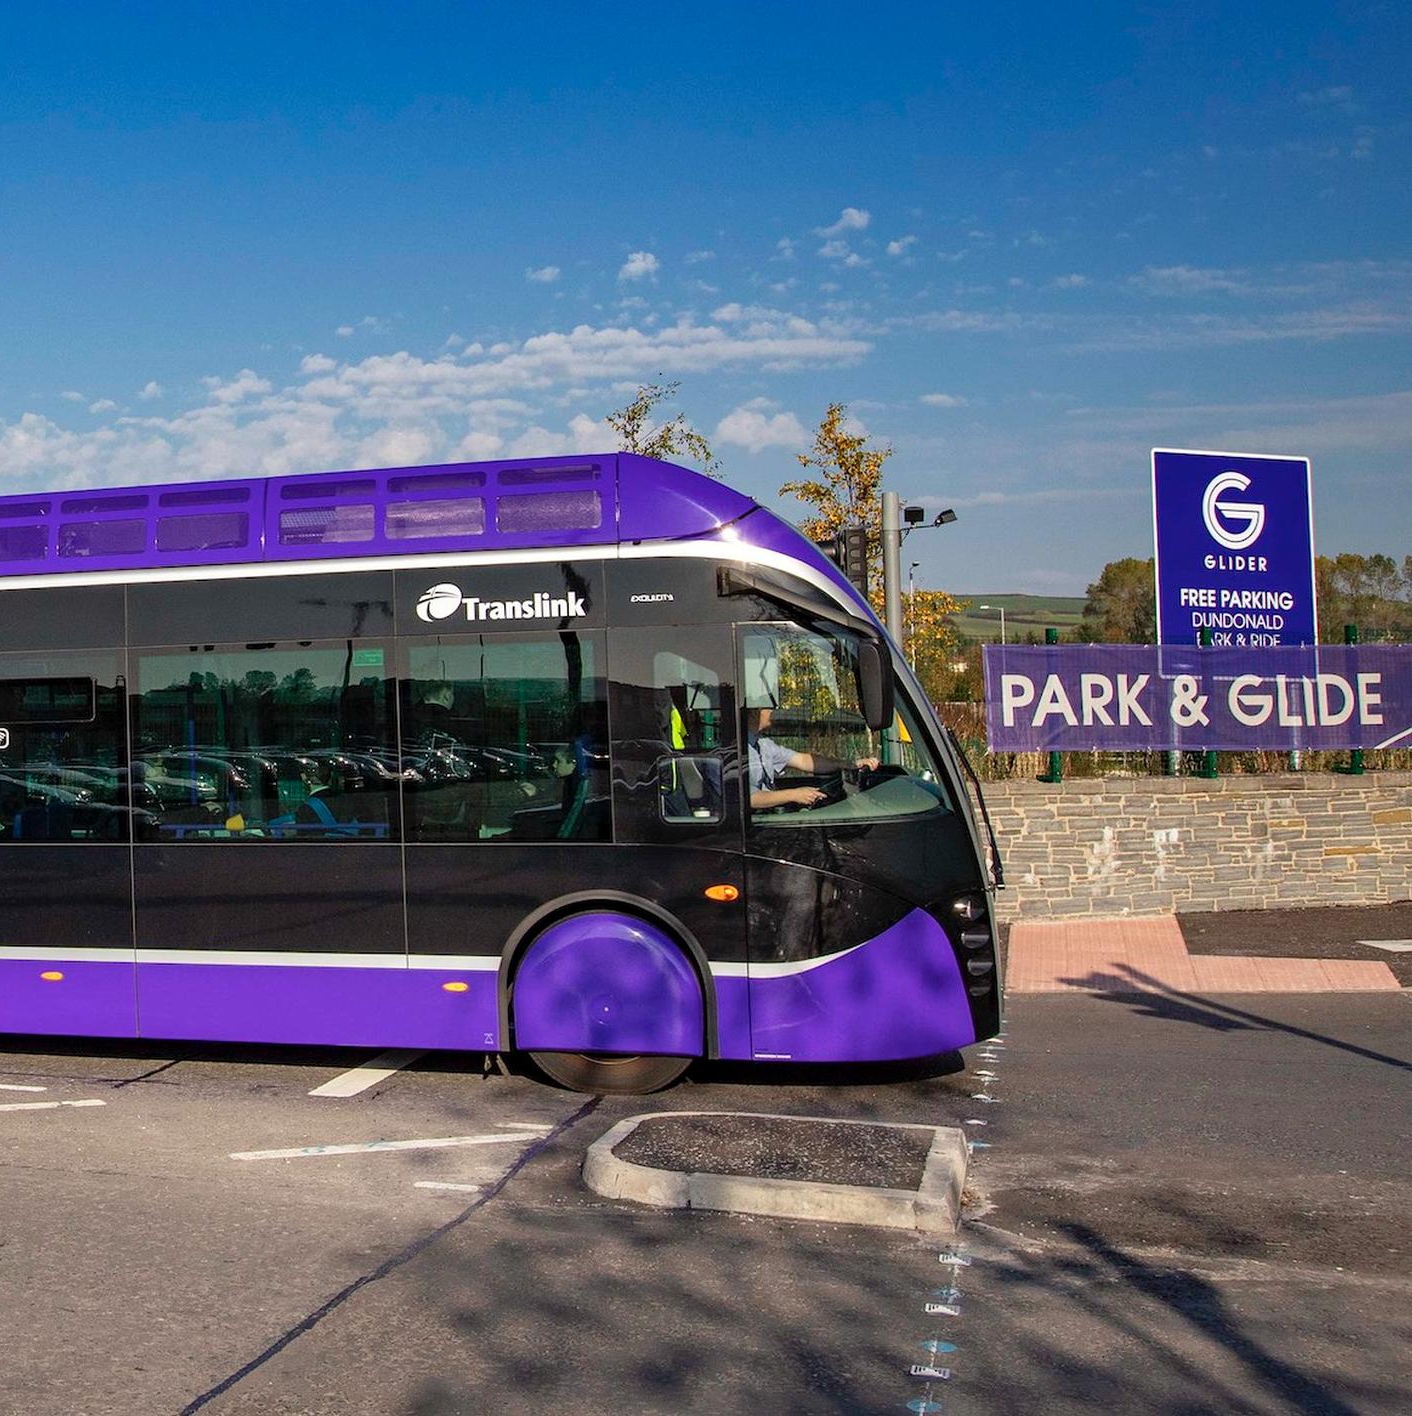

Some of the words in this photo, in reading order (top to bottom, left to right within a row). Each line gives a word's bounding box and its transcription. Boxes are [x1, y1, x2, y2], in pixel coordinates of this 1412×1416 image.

[1204, 554, 1268, 572] GLIDER
[461, 591, 586, 621] Translink
[1180, 588, 1216, 607] FREE
[1220, 590, 1294, 610] PARKING
[1192, 612, 1284, 630] DUNDONALD
[1001, 674, 1153, 727] PARK
[1170, 674, 1210, 727] &
[1228, 673, 1384, 727] GLIDE
